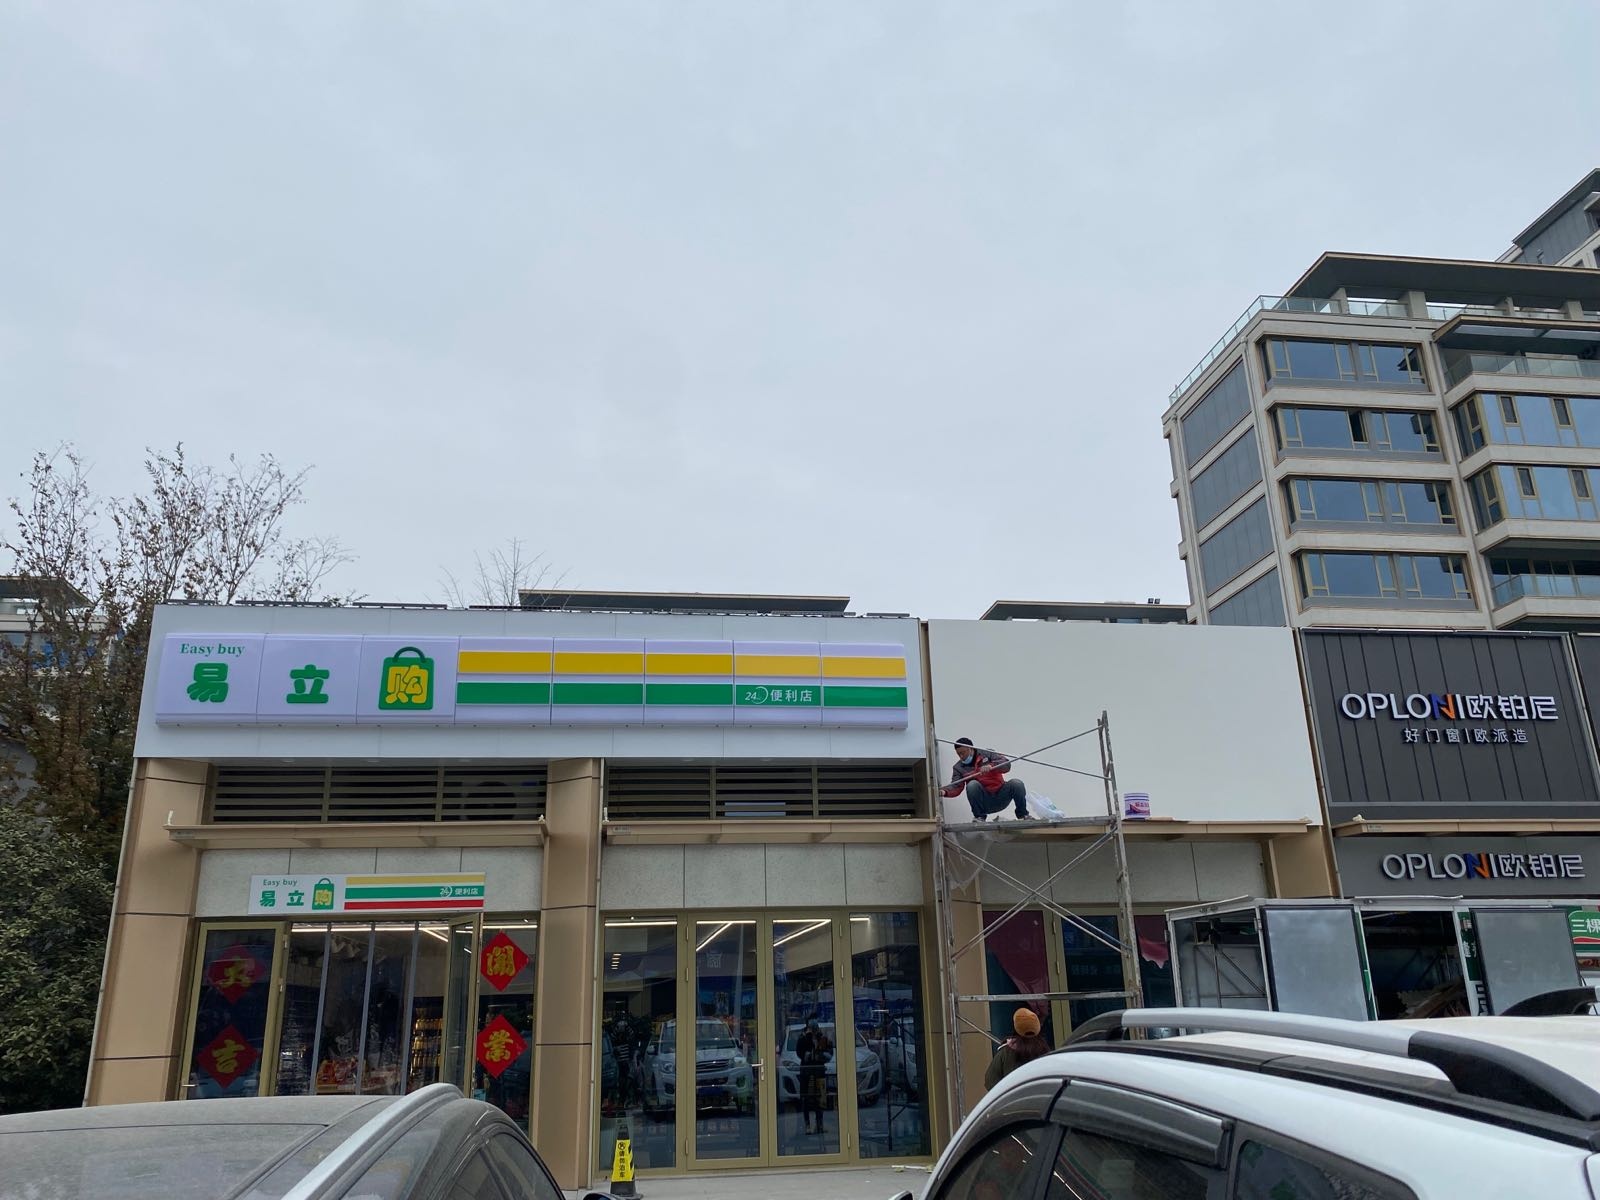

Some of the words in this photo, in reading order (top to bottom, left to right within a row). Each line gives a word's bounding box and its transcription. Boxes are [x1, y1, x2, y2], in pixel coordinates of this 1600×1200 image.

[179, 643, 214, 657] Easy
[217, 643, 246, 657] buy
[186, 662, 430, 704] 易立购
[770, 689, 813, 702] 便利店
[262, 879, 281, 888] Easy
[282, 878, 298, 887] buy
[259, 889, 333, 907] 易立购
[455, 887, 479, 896] 便利店
